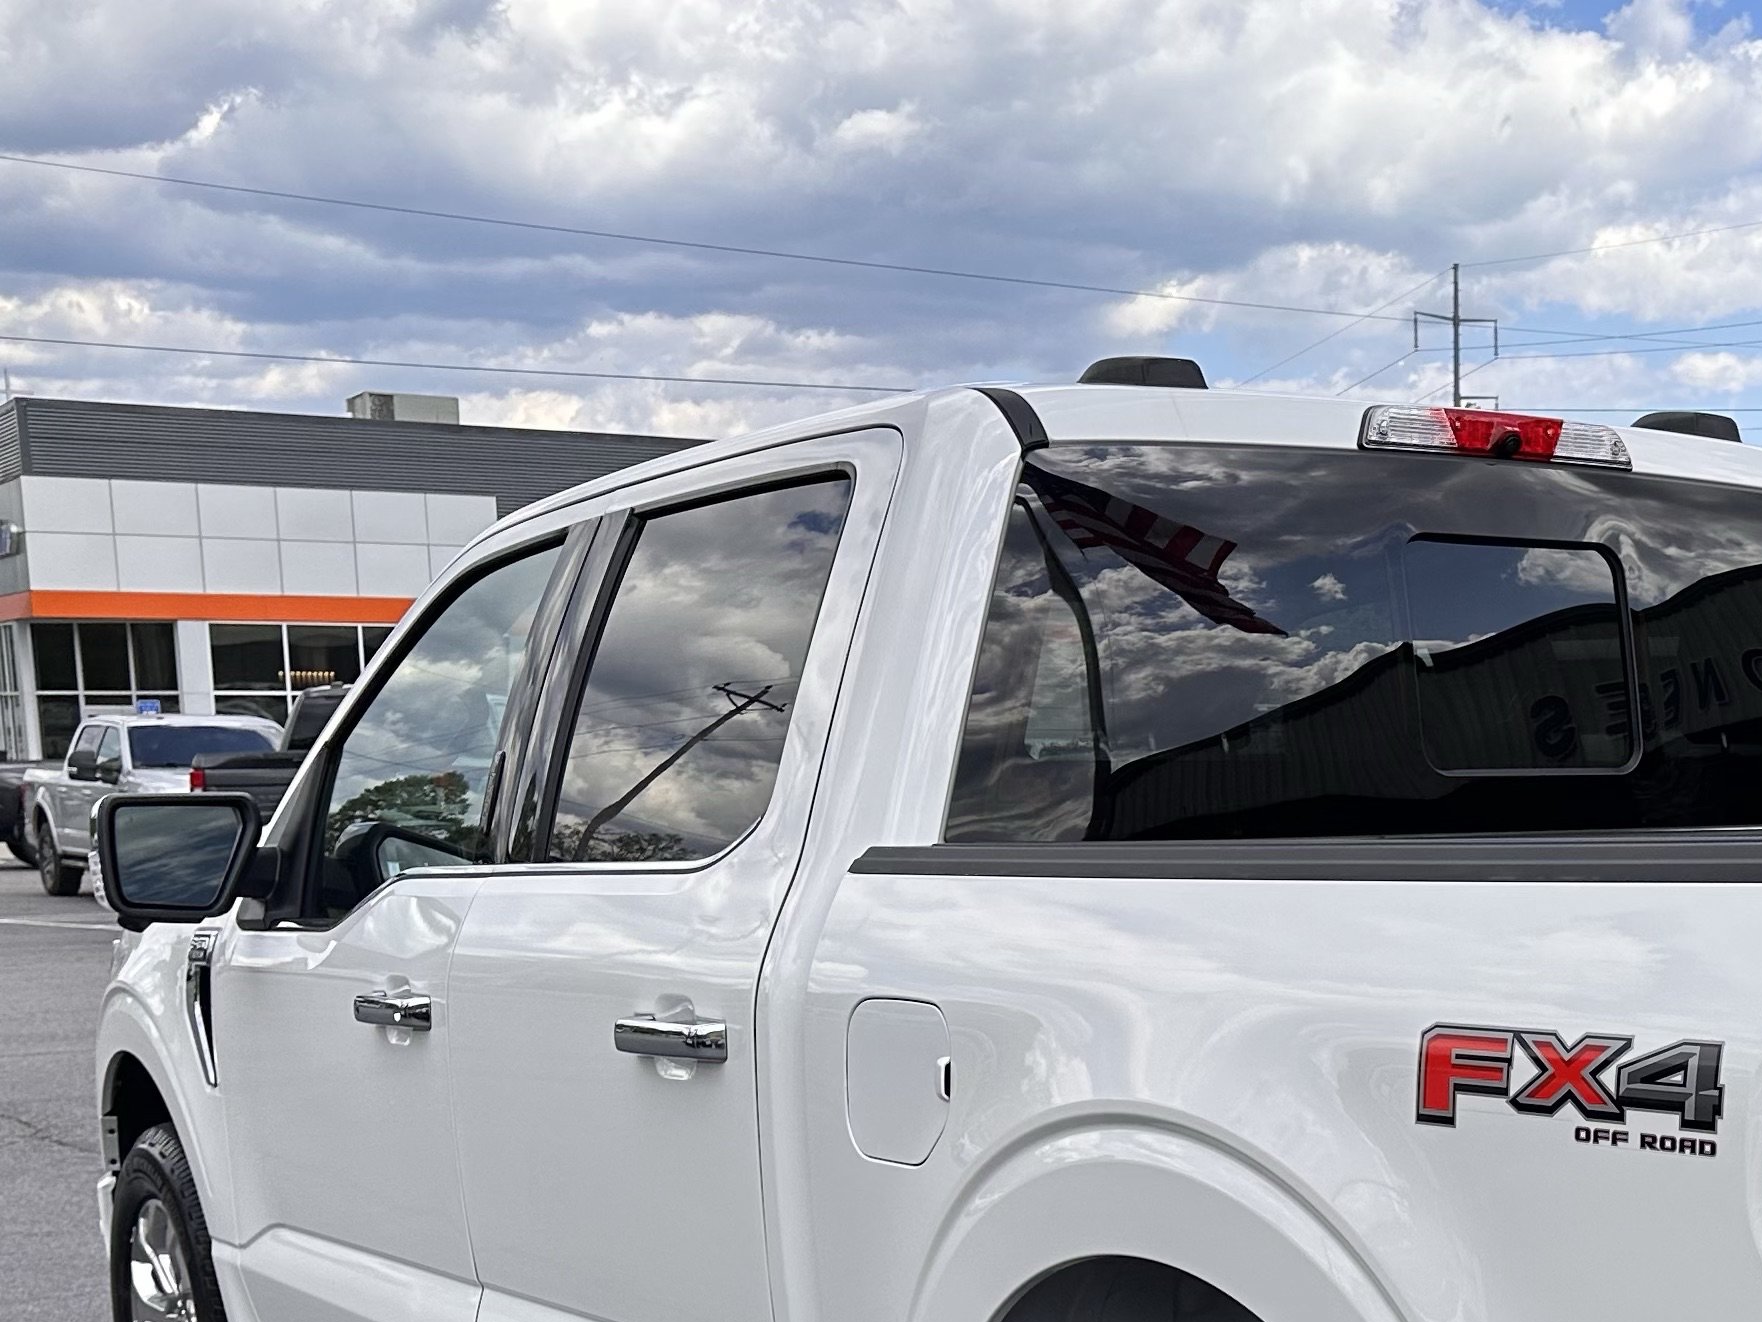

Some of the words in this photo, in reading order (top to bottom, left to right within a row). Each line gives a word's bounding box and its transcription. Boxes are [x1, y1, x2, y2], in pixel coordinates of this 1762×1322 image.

[1415, 1021, 1725, 1134] FX4
[1573, 1125, 1630, 1148] OFF
[1639, 1132, 1718, 1158] ROAD
